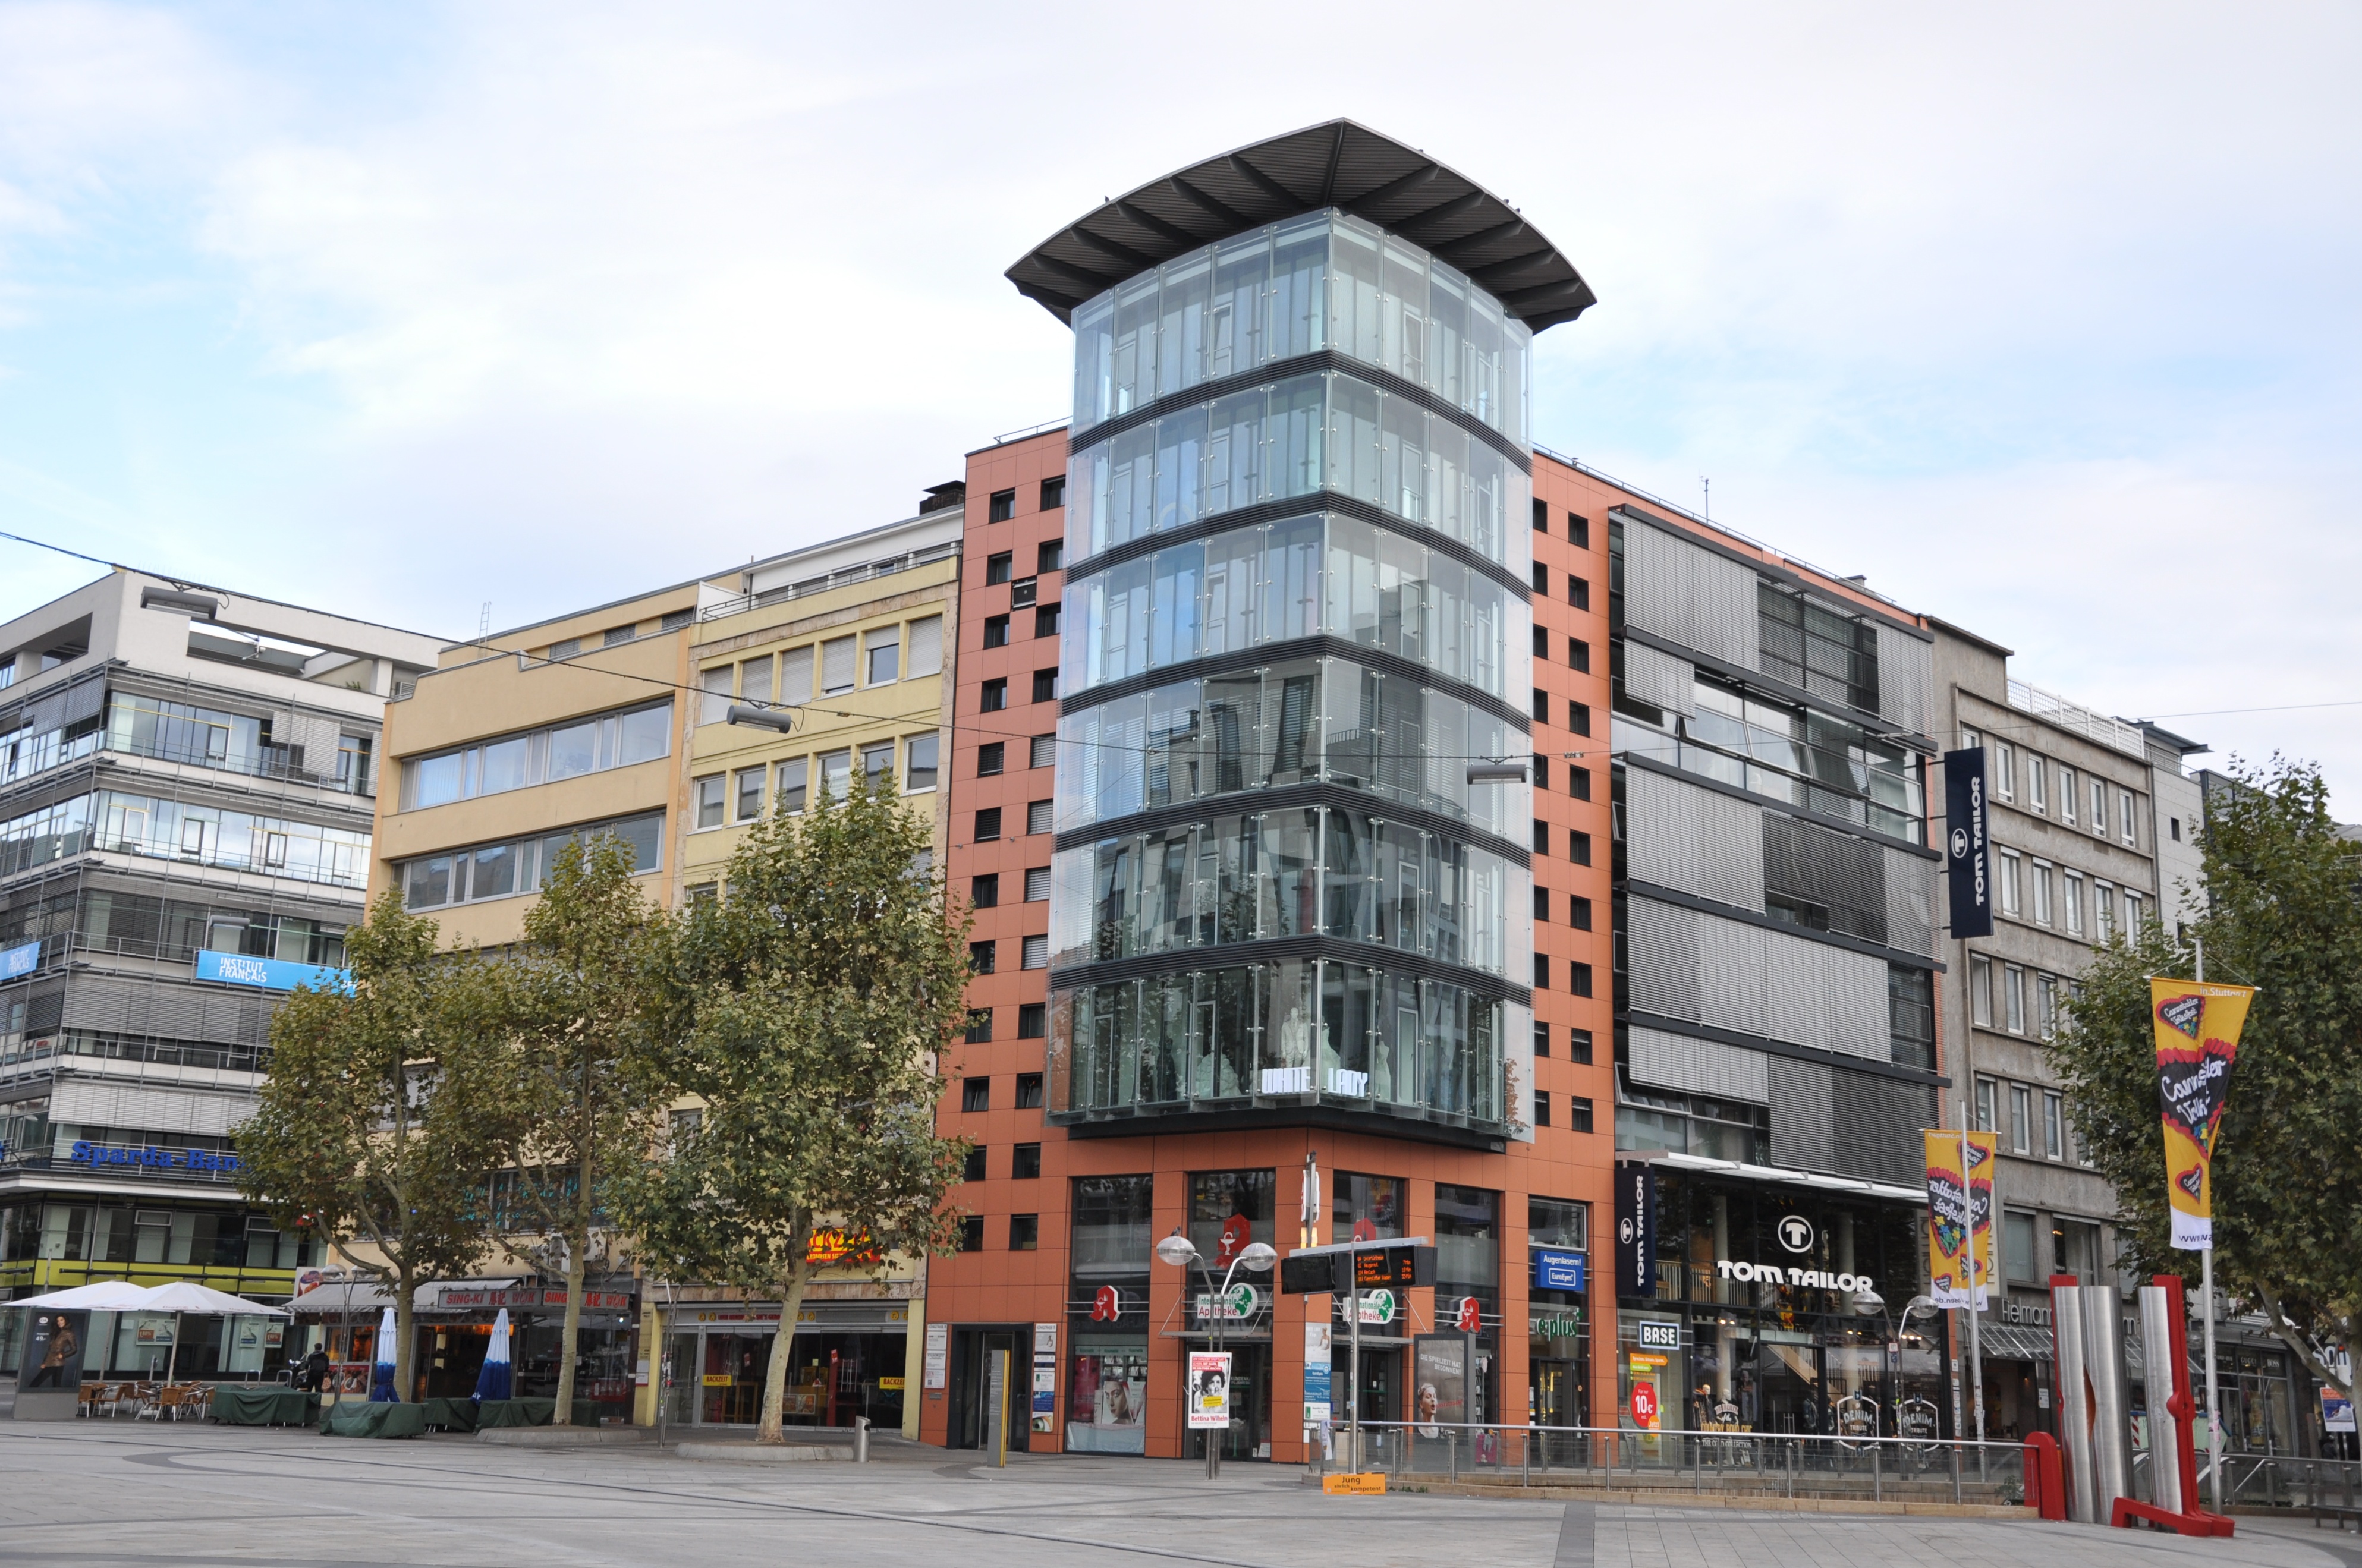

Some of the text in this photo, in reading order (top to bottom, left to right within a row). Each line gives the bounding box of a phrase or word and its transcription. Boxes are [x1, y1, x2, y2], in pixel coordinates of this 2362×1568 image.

[1971, 776, 1984, 906] TOM TAILOR
[220, 957, 264, 973] INSTITUT
[219, 966, 268, 983] FRANÇAIS
[1262, 1066, 1369, 1098] WHITE LADY
[1543, 1254, 1581, 1266] Augenlasern!
[1552, 1273, 1572, 1282] EuroEyes
[1717, 1260, 1873, 1292] TOM TAILOR
[447, 1292, 485, 1305] SING-KI
[1348, 1309, 1381, 1321] Aotheke
[1644, 1326, 1675, 1345] BASE
[1429, 1355, 1451, 1366] SPIELZEIT
[1434, 1364, 1461, 1375] BEGONNEN!
[1844, 1410, 1873, 1425] DENIM
[1903, 1413, 1932, 1427] DENIM
[1341, 1476, 1361, 1485] Jung
